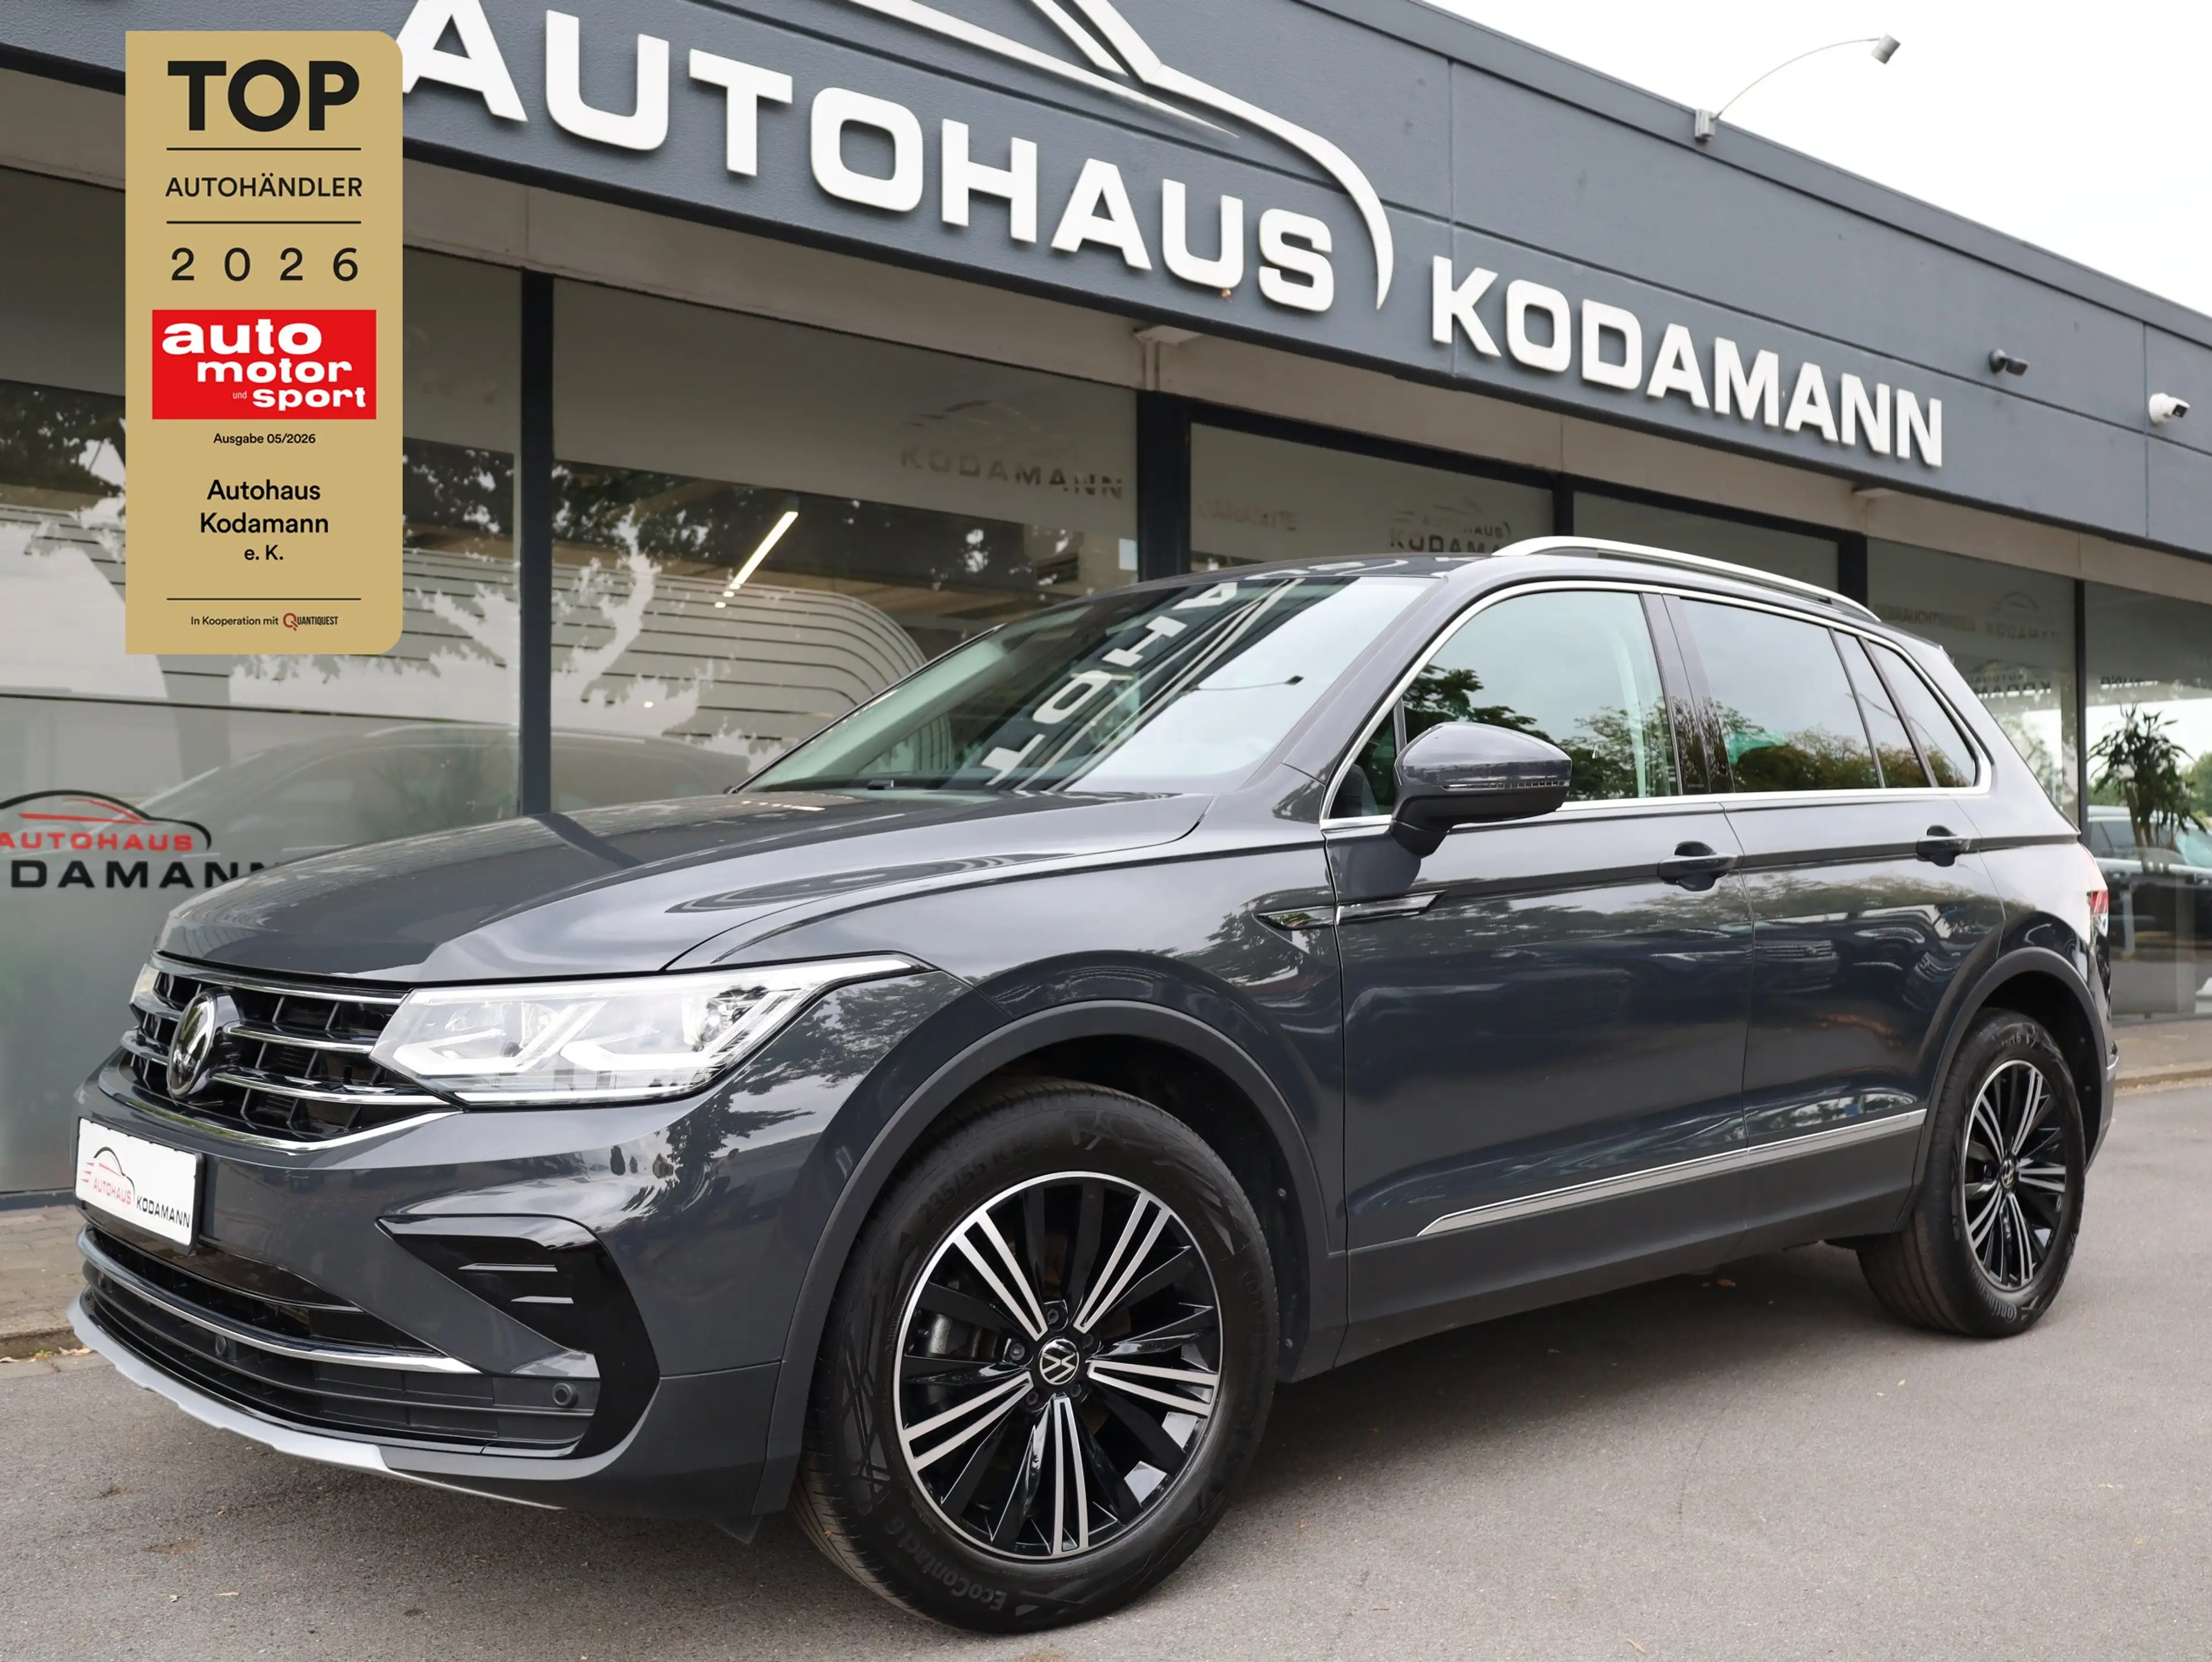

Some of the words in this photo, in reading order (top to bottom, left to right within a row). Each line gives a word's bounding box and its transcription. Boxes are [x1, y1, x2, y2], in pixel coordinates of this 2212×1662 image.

[395, 0, 1334, 312] AUTOHAUS
[1432, 254, 1942, 467] KODAMANN
[0, 832, 193, 851] AUTOHAUS
[11, 859, 278, 889] DAMAN
[92, 1177, 132, 1205] AUTOHAUS
[136, 1195, 190, 1229] KODAMANN
